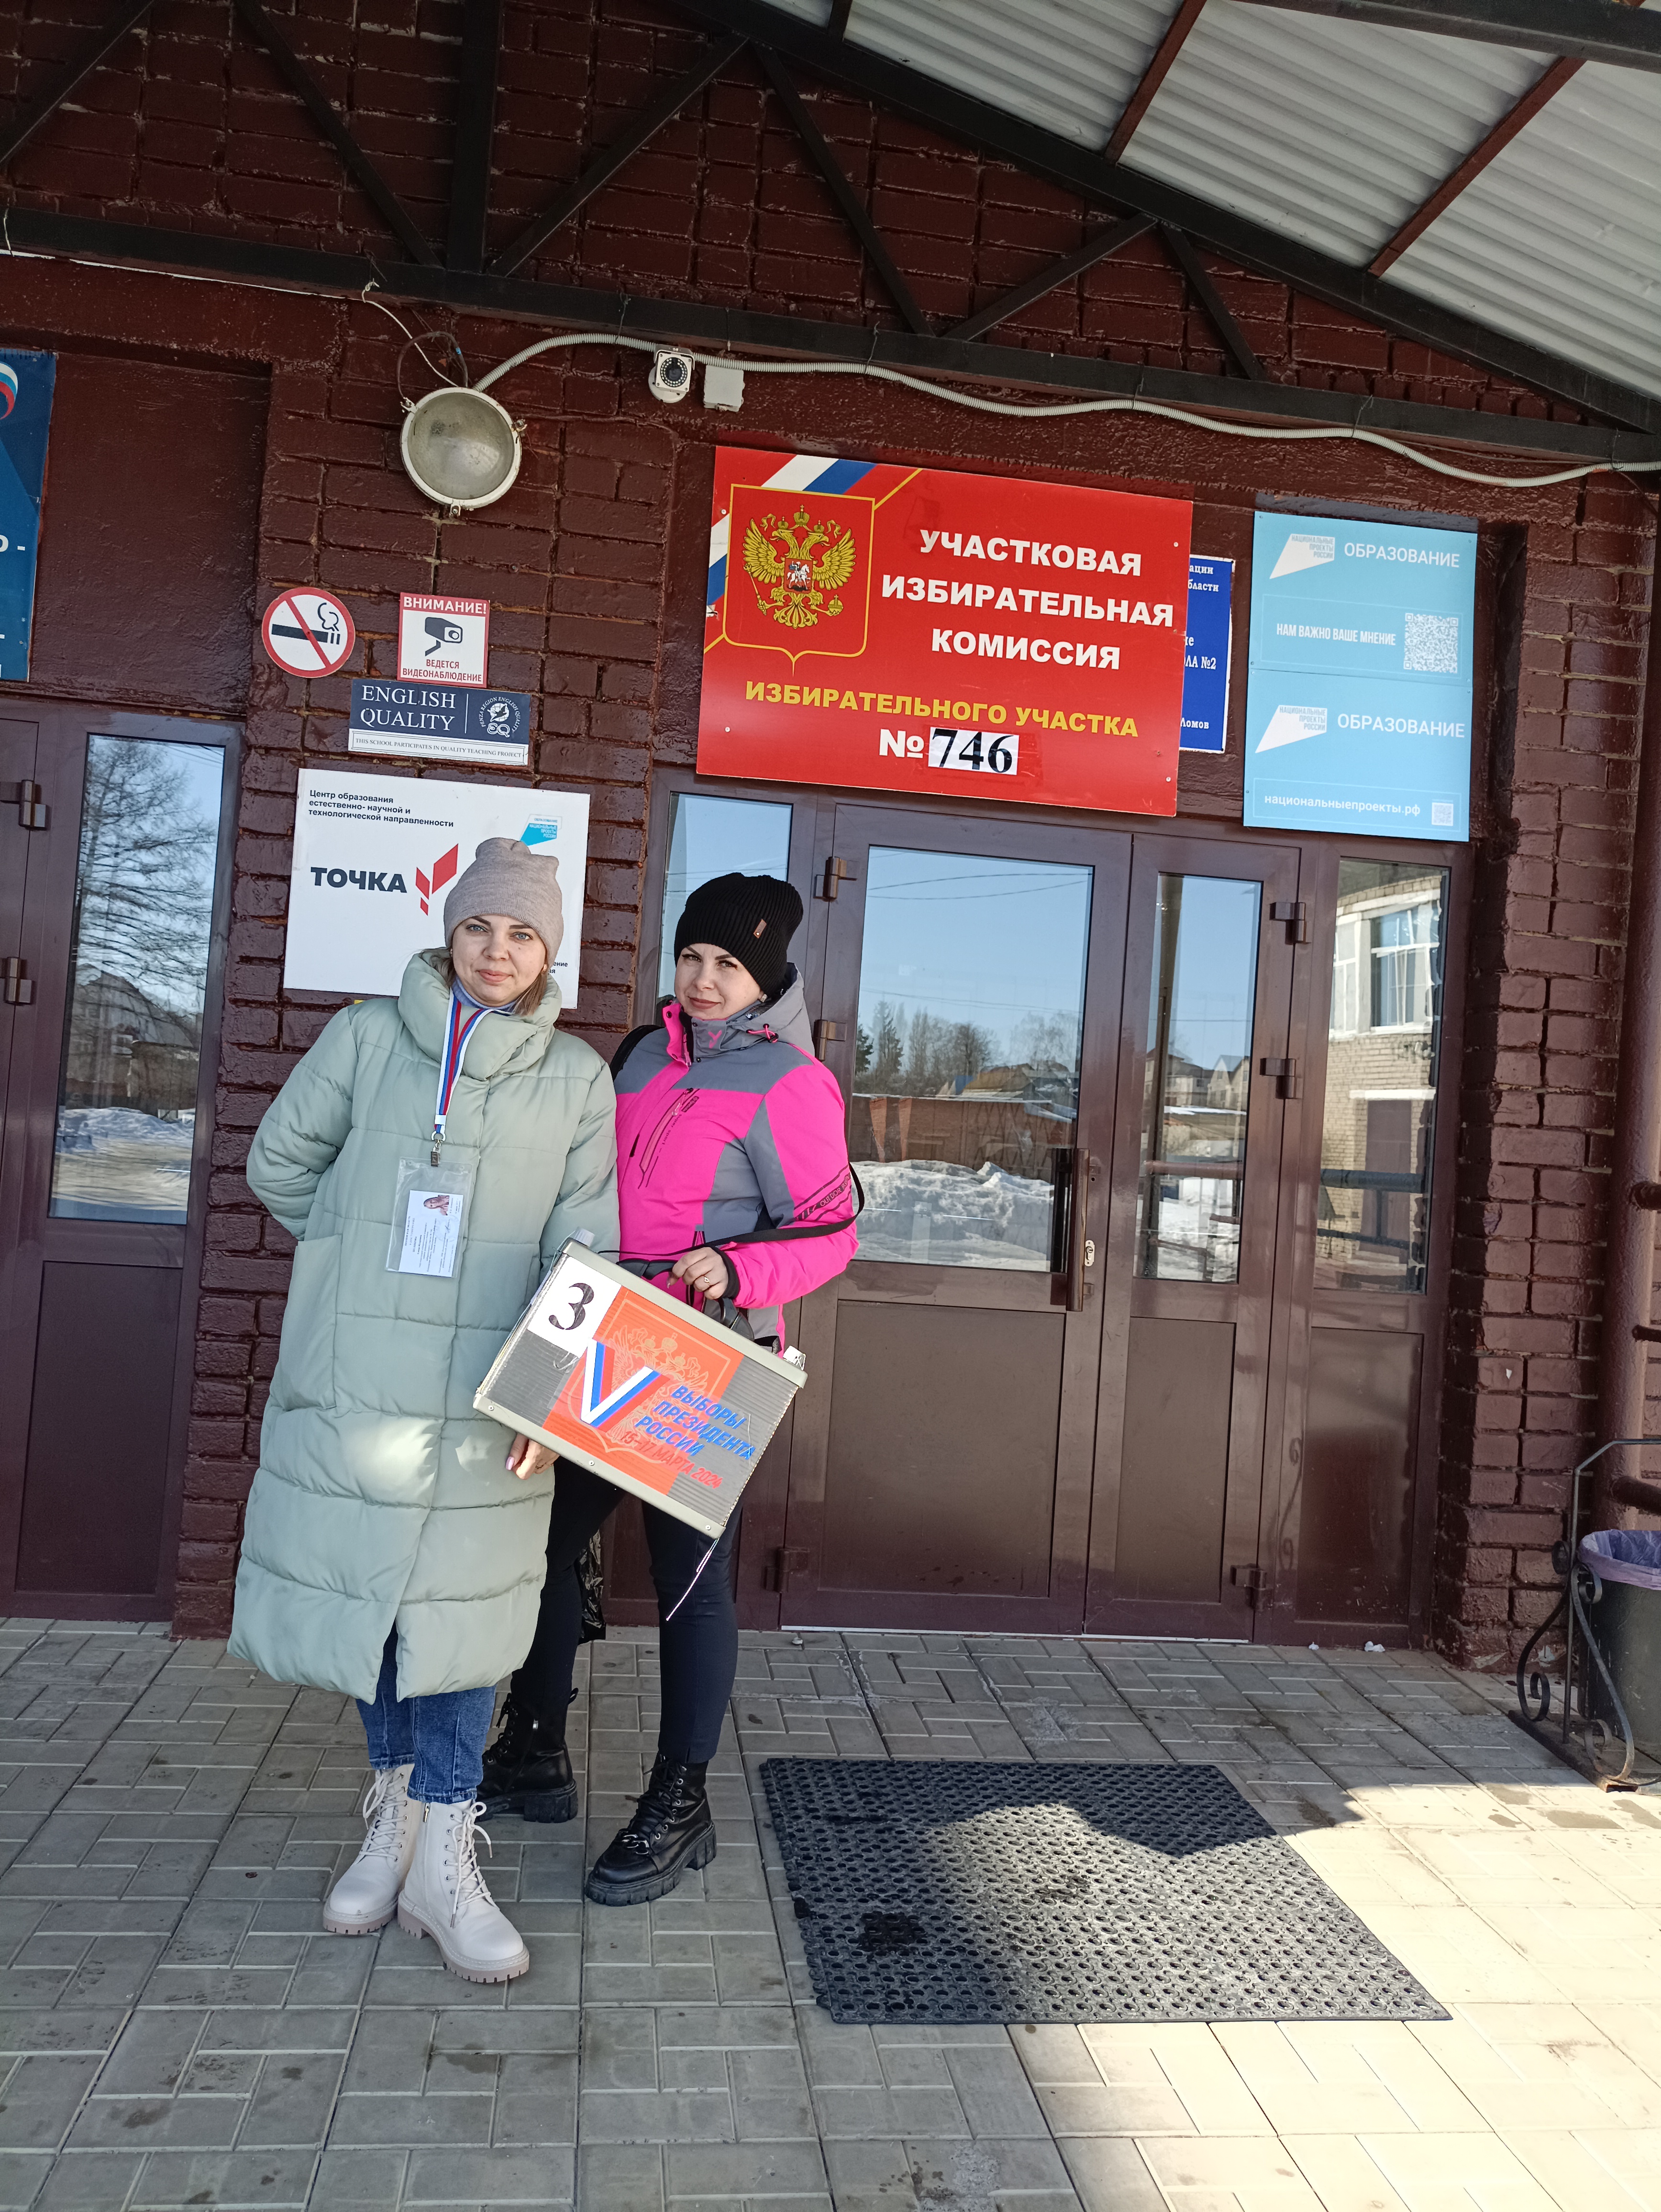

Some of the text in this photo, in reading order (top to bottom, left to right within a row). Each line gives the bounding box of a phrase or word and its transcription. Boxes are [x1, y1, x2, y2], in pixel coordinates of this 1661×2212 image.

[920, 529, 1141, 576] УЧАСТКОВАЯ
[1313, 551, 1333, 559] РОССИИ
[1344, 542, 1460, 568] ОБРАЗОВАНИЕ
[403, 597, 487, 614] ВНИМАНИЕ!
[882, 575, 1174, 627] ИЗБИРАТЕЛЬНАЯ
[1276, 623, 1396, 646] НАМ ВАЖНО ВАШЕ МНЕНИЕ
[931, 629, 1120, 670] КОМИССИЯ
[426, 659, 459, 669] ВЕДЕТСЯ
[1184, 655, 1216, 670] ЛА №2
[402, 668, 482, 682] ВИДЕОНАБЛЮДЕНИЕ
[361, 685, 456, 709] ENGLISH
[360, 708, 454, 731] QUALITY
[481, 697, 497, 711] REGION
[498, 697, 519, 711] ENGLISH
[512, 711, 521, 733] QUALITY
[745, 681, 1139, 737] ИЗБИРАТЕЛЬНОГО УЧАСТКА
[1279, 706, 1326, 716] НАЦИОНАЛЬНЫЕ
[1299, 715, 1326, 723] ПРОЕКТЫ
[1304, 723, 1326, 731] РОССИИ
[1337, 714, 1465, 738] ОБРАЗОВАНИЕ
[310, 790, 393, 803] Центр образования
[1264, 794, 1421, 817] национальныепроекты.рф
[309, 809, 454, 827] технологической направленности
[367, 805, 403, 814] научной
[310, 867, 407, 894] ТОЧКА
[549, 1282, 595, 1330] 3
[671, 1385, 746, 1429] ВЫБОРЫ
[634, 1415, 705, 1457] РОССИИ
[653, 1400, 756, 1460] ПРЕЗИДЕНТА
[652, 1447, 695, 1475] МАРТА
[691, 1467, 723, 1489] 2024
